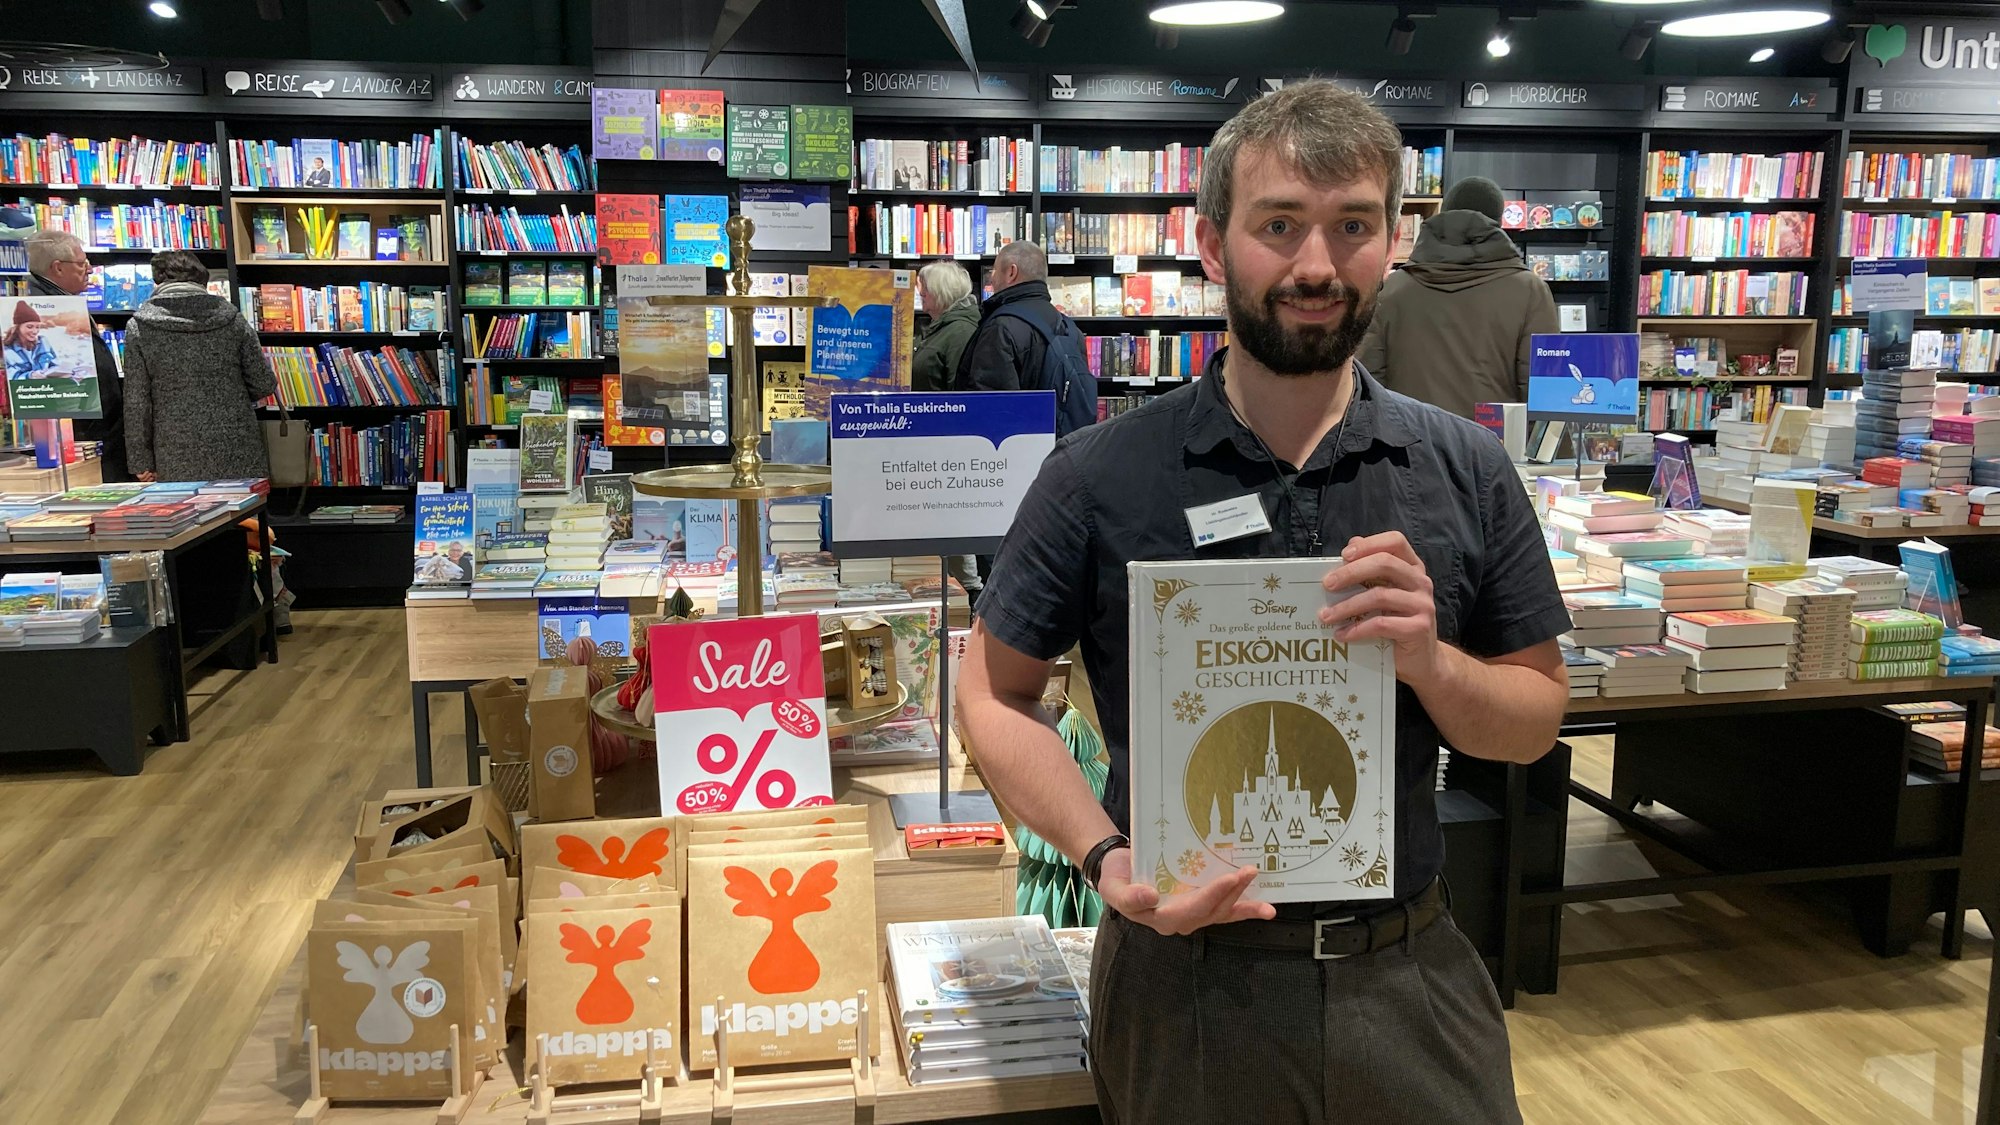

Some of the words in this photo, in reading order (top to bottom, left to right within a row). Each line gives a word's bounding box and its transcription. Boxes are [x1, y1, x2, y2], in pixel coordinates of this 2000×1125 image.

[23, 70, 62, 85] REISE
[255, 72, 300, 92] REISE
[342, 75, 402, 94] LÄNDER
[406, 80, 431, 94] A-Z
[862, 72, 950, 91] BIOGRAFIEN
[487, 79, 545, 95] WANDERN
[554, 80, 563, 95] &
[1086, 78, 1163, 96] HISTORISCHE
[1170, 79, 1218, 96] Romane
[1385, 85, 1433, 99] ROMANE
[1510, 84, 1587, 103] HÖRBÜCHER
[1704, 90, 1760, 108] ROMANE
[1789, 92, 1799, 107] A
[817, 325, 851, 336] Bewegt
[853, 328, 869, 336] uns
[817, 338, 834, 347] und
[837, 340, 872, 349] unseren
[1536, 348, 1571, 357] Romane
[816, 350, 858, 361] Planeten.
[839, 404, 862, 414] Von
[864, 403, 900, 414] Thalia
[903, 402, 966, 413] Euskirchen
[840, 416, 912, 438] ausgewählt:
[882, 460, 938, 474] Entfaltet
[941, 459, 966, 472] den
[970, 458, 1008, 473] Engel
[885, 479, 906, 491] bei
[910, 477, 943, 490] euch
[946, 476, 1004, 489] Zuhause
[886, 503, 920, 511] zeitloser
[922, 500, 1004, 511] Weihnachtsschmuck
[1247, 598, 1298, 619] Disney
[1209, 624, 1226, 633] Das
[1229, 624, 1255, 635] große
[1257, 624, 1292, 635] goldene
[1295, 621, 1317, 630] Buch
[1320, 622, 1335, 630] der
[957, 636, 967, 660] TOPP
[1196, 636, 1349, 669] EISKÖNIGIN
[693, 638, 791, 693] Sale
[1195, 668, 1349, 689] GESCHICHTEN
[778, 701, 816, 733] 50%
[697, 729, 797, 810] %
[684, 788, 728, 808] 50%
[913, 826, 996, 835] klappa
[701, 997, 859, 1037] klappa
[540, 1028, 672, 1058] klappa
[319, 1047, 452, 1077] klappa
